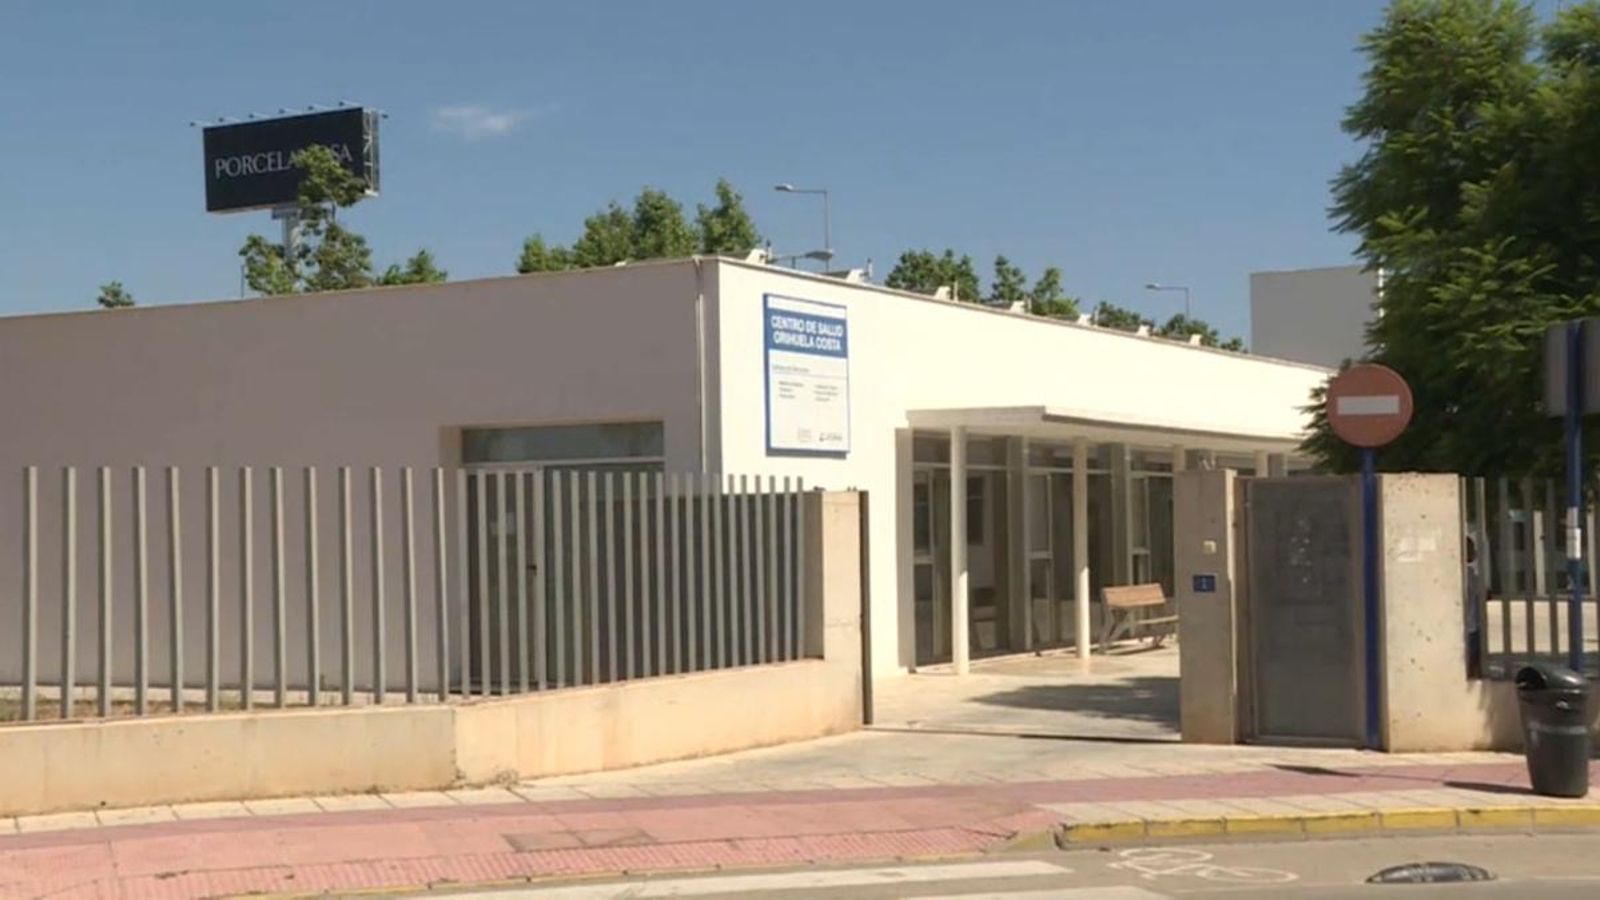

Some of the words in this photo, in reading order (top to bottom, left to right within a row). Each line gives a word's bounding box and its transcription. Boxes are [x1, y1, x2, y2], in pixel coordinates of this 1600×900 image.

[215, 143, 353, 179] PORCELASA
[771, 315, 805, 332] CENTRO
[806, 320, 816, 334] DE
[818, 322, 844, 337] SALUD
[774, 331, 815, 348] ORIHUELA
[816, 336, 841, 351] COSTA
